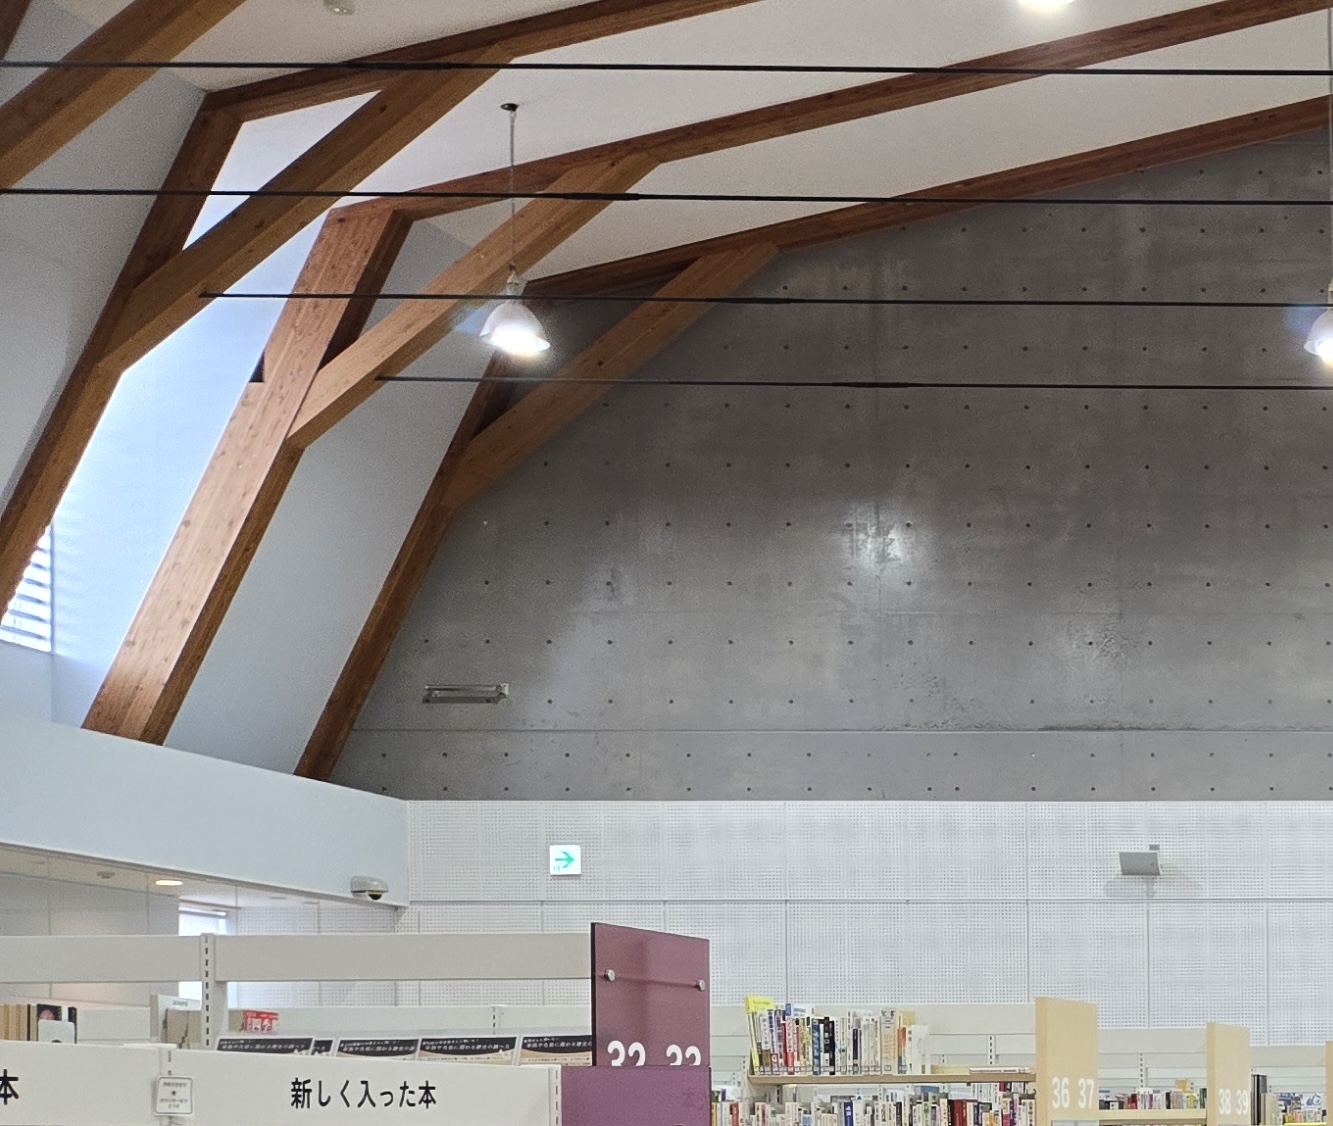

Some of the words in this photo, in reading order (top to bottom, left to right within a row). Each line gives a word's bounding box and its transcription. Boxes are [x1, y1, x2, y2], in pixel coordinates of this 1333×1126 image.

[290, 1078, 437, 1110] 新しく入った本
[1051, 1077, 1070, 1109] 36
[1078, 1078, 1095, 1109] 37
[1218, 1088, 1232, 1115] 38
[1235, 1089, 1249, 1115] 39
